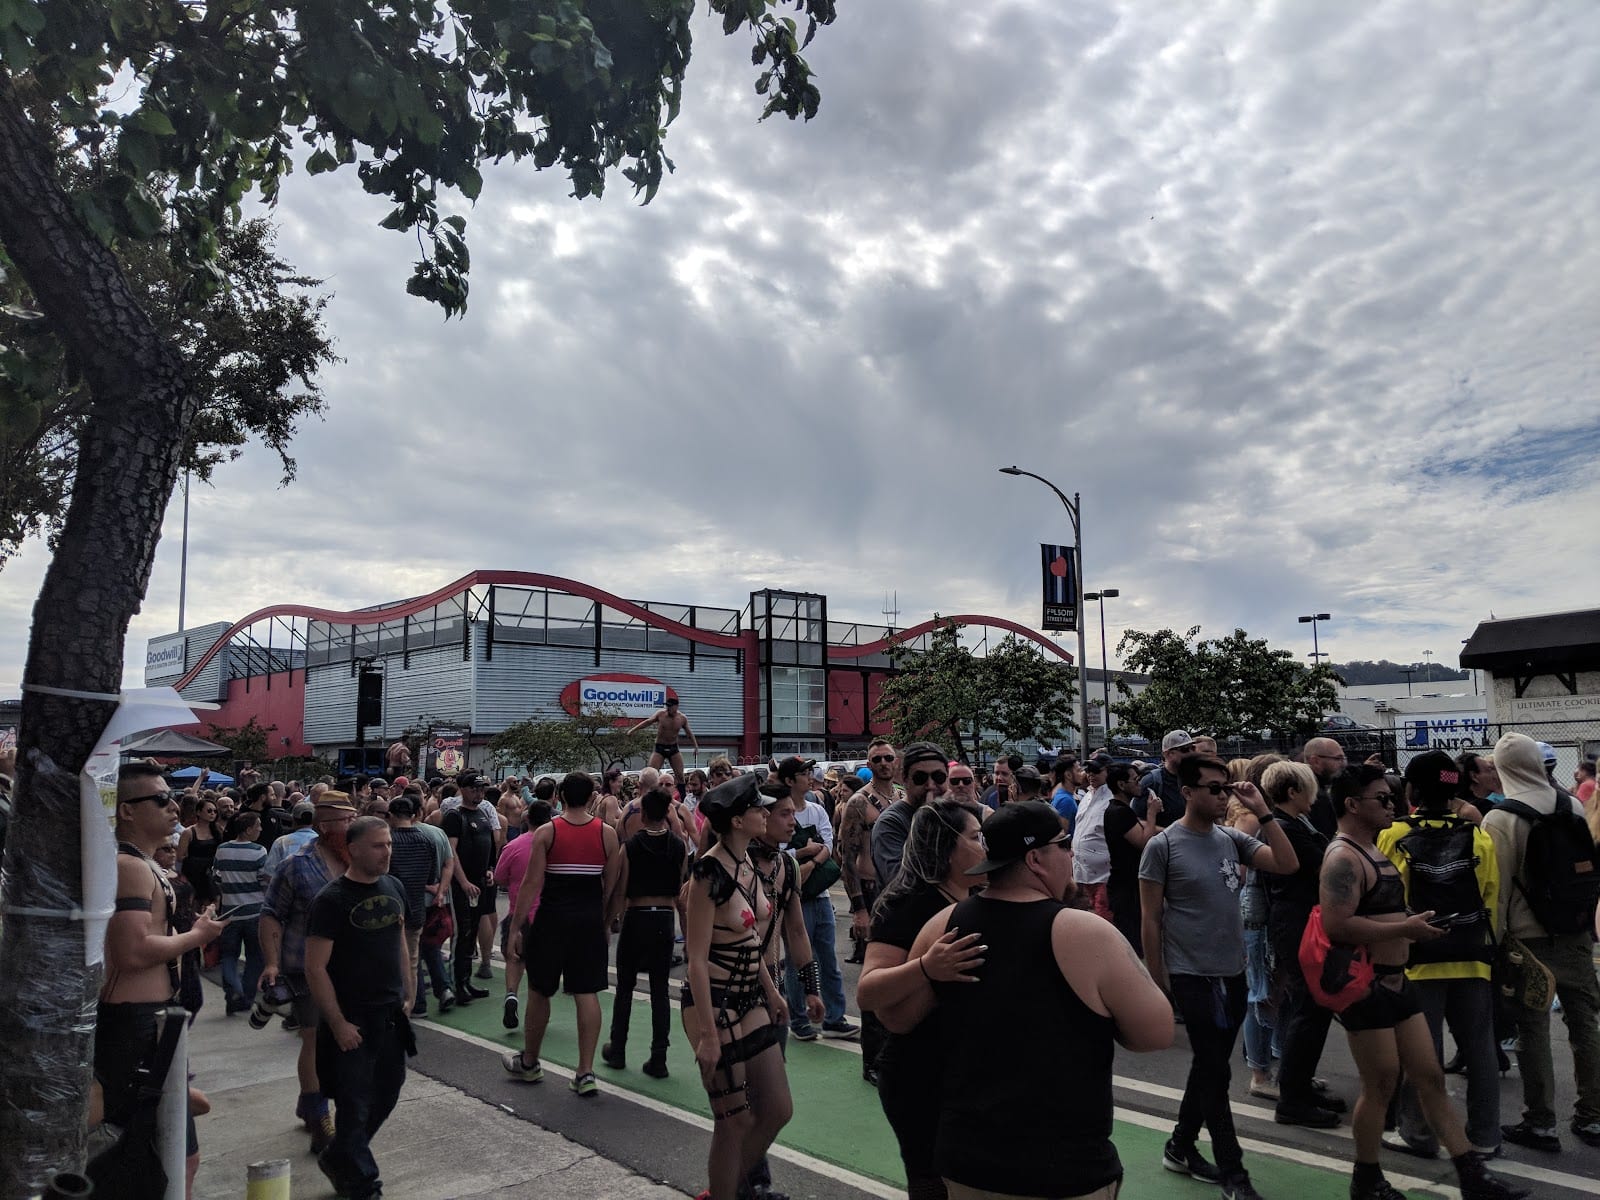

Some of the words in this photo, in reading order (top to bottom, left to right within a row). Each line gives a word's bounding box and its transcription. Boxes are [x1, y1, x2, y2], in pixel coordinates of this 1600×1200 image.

[1046, 608, 1074, 617] FOLSOM
[146, 646, 178, 664] Goodwill
[583, 688, 653, 702] Goodwill
[1516, 701, 1561, 709] ULTIMATE
[1431, 719, 1457, 733] WE
[1432, 737, 1474, 751] INTO
